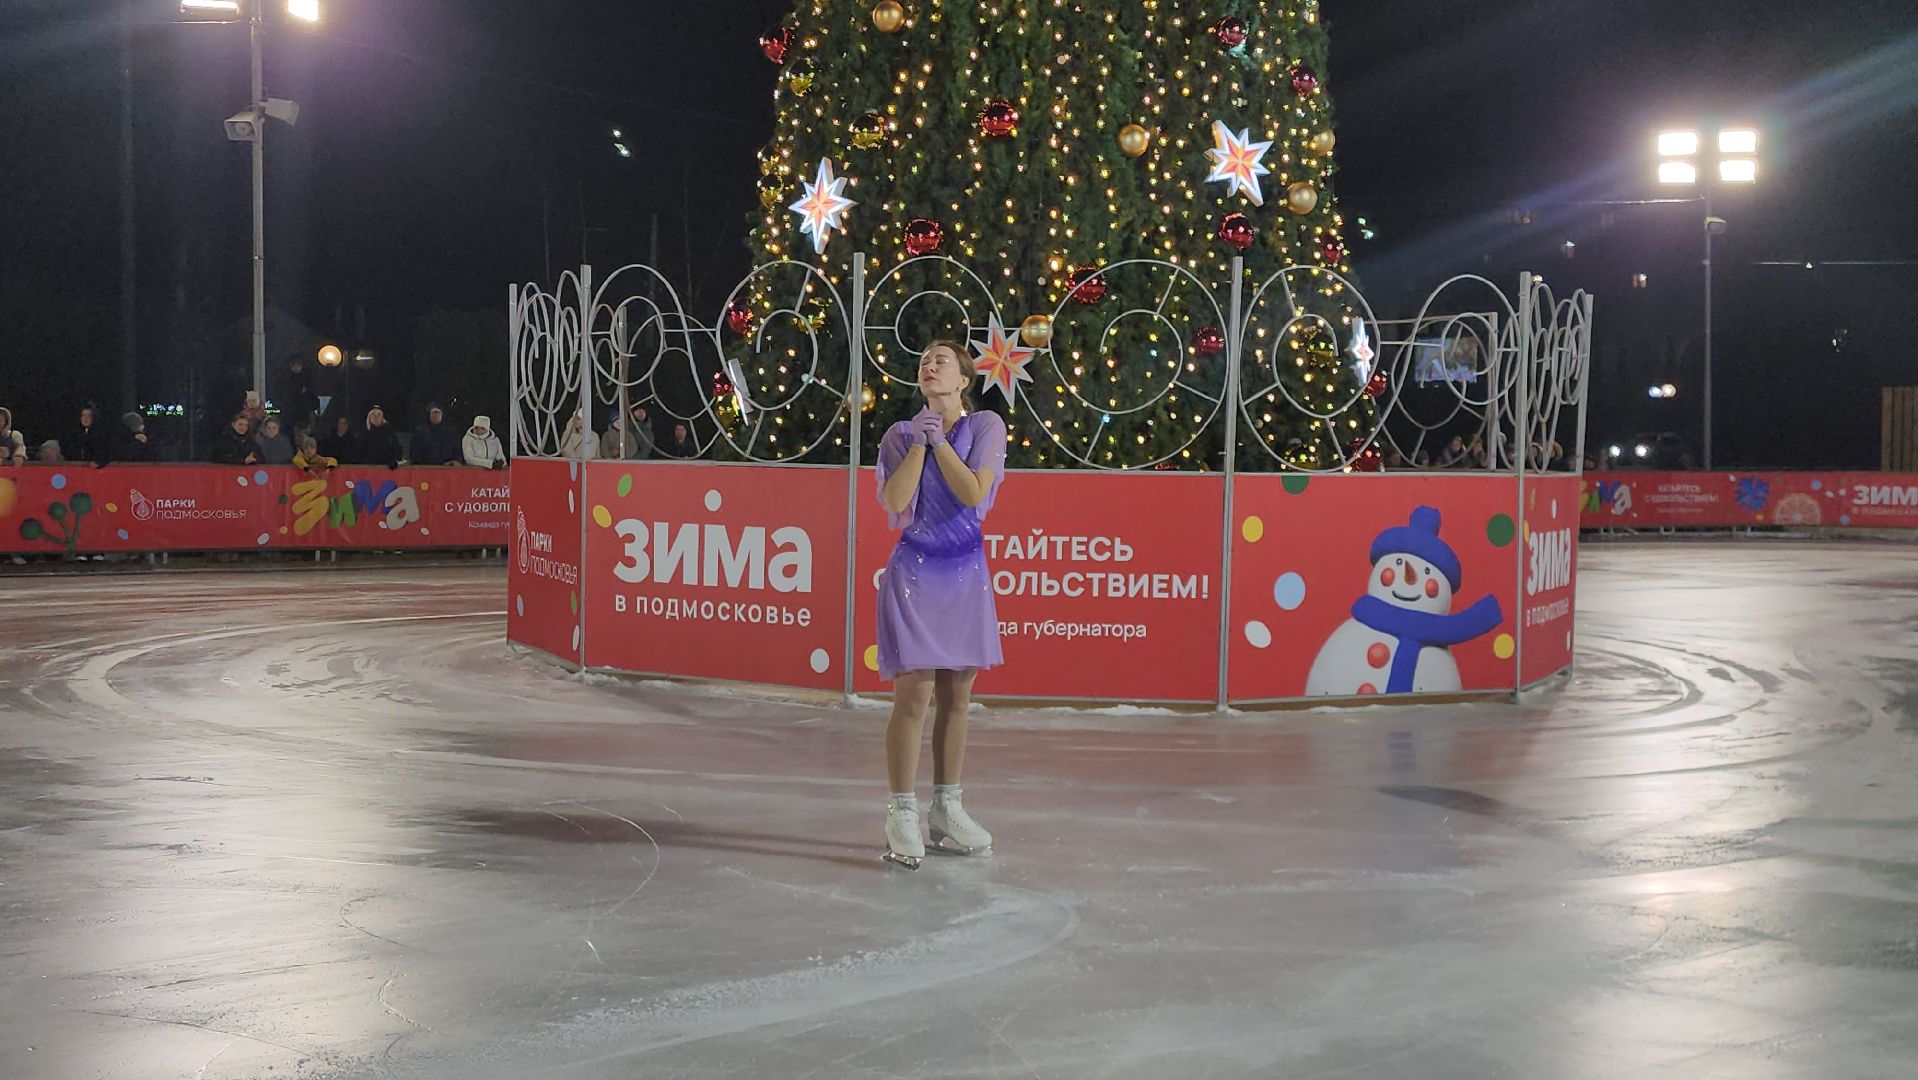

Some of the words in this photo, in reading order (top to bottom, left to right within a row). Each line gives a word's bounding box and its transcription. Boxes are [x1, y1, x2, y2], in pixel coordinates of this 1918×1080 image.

[471, 486, 511, 498] КАТАЙ
[156, 499, 196, 508] ПАРКИ
[444, 502, 454, 512] С
[156, 510, 246, 519] ПОДМОСКОВЬЯ
[530, 531, 552, 552] ПАРКИ
[984, 528, 1134, 562] ТАЙТЕСЬ
[530, 555, 578, 585] ПОДМОСКОВЬЯ
[992, 570, 1209, 600] ОЛЬСТВИЕМ!
[1024, 619, 1147, 643] губернатора
